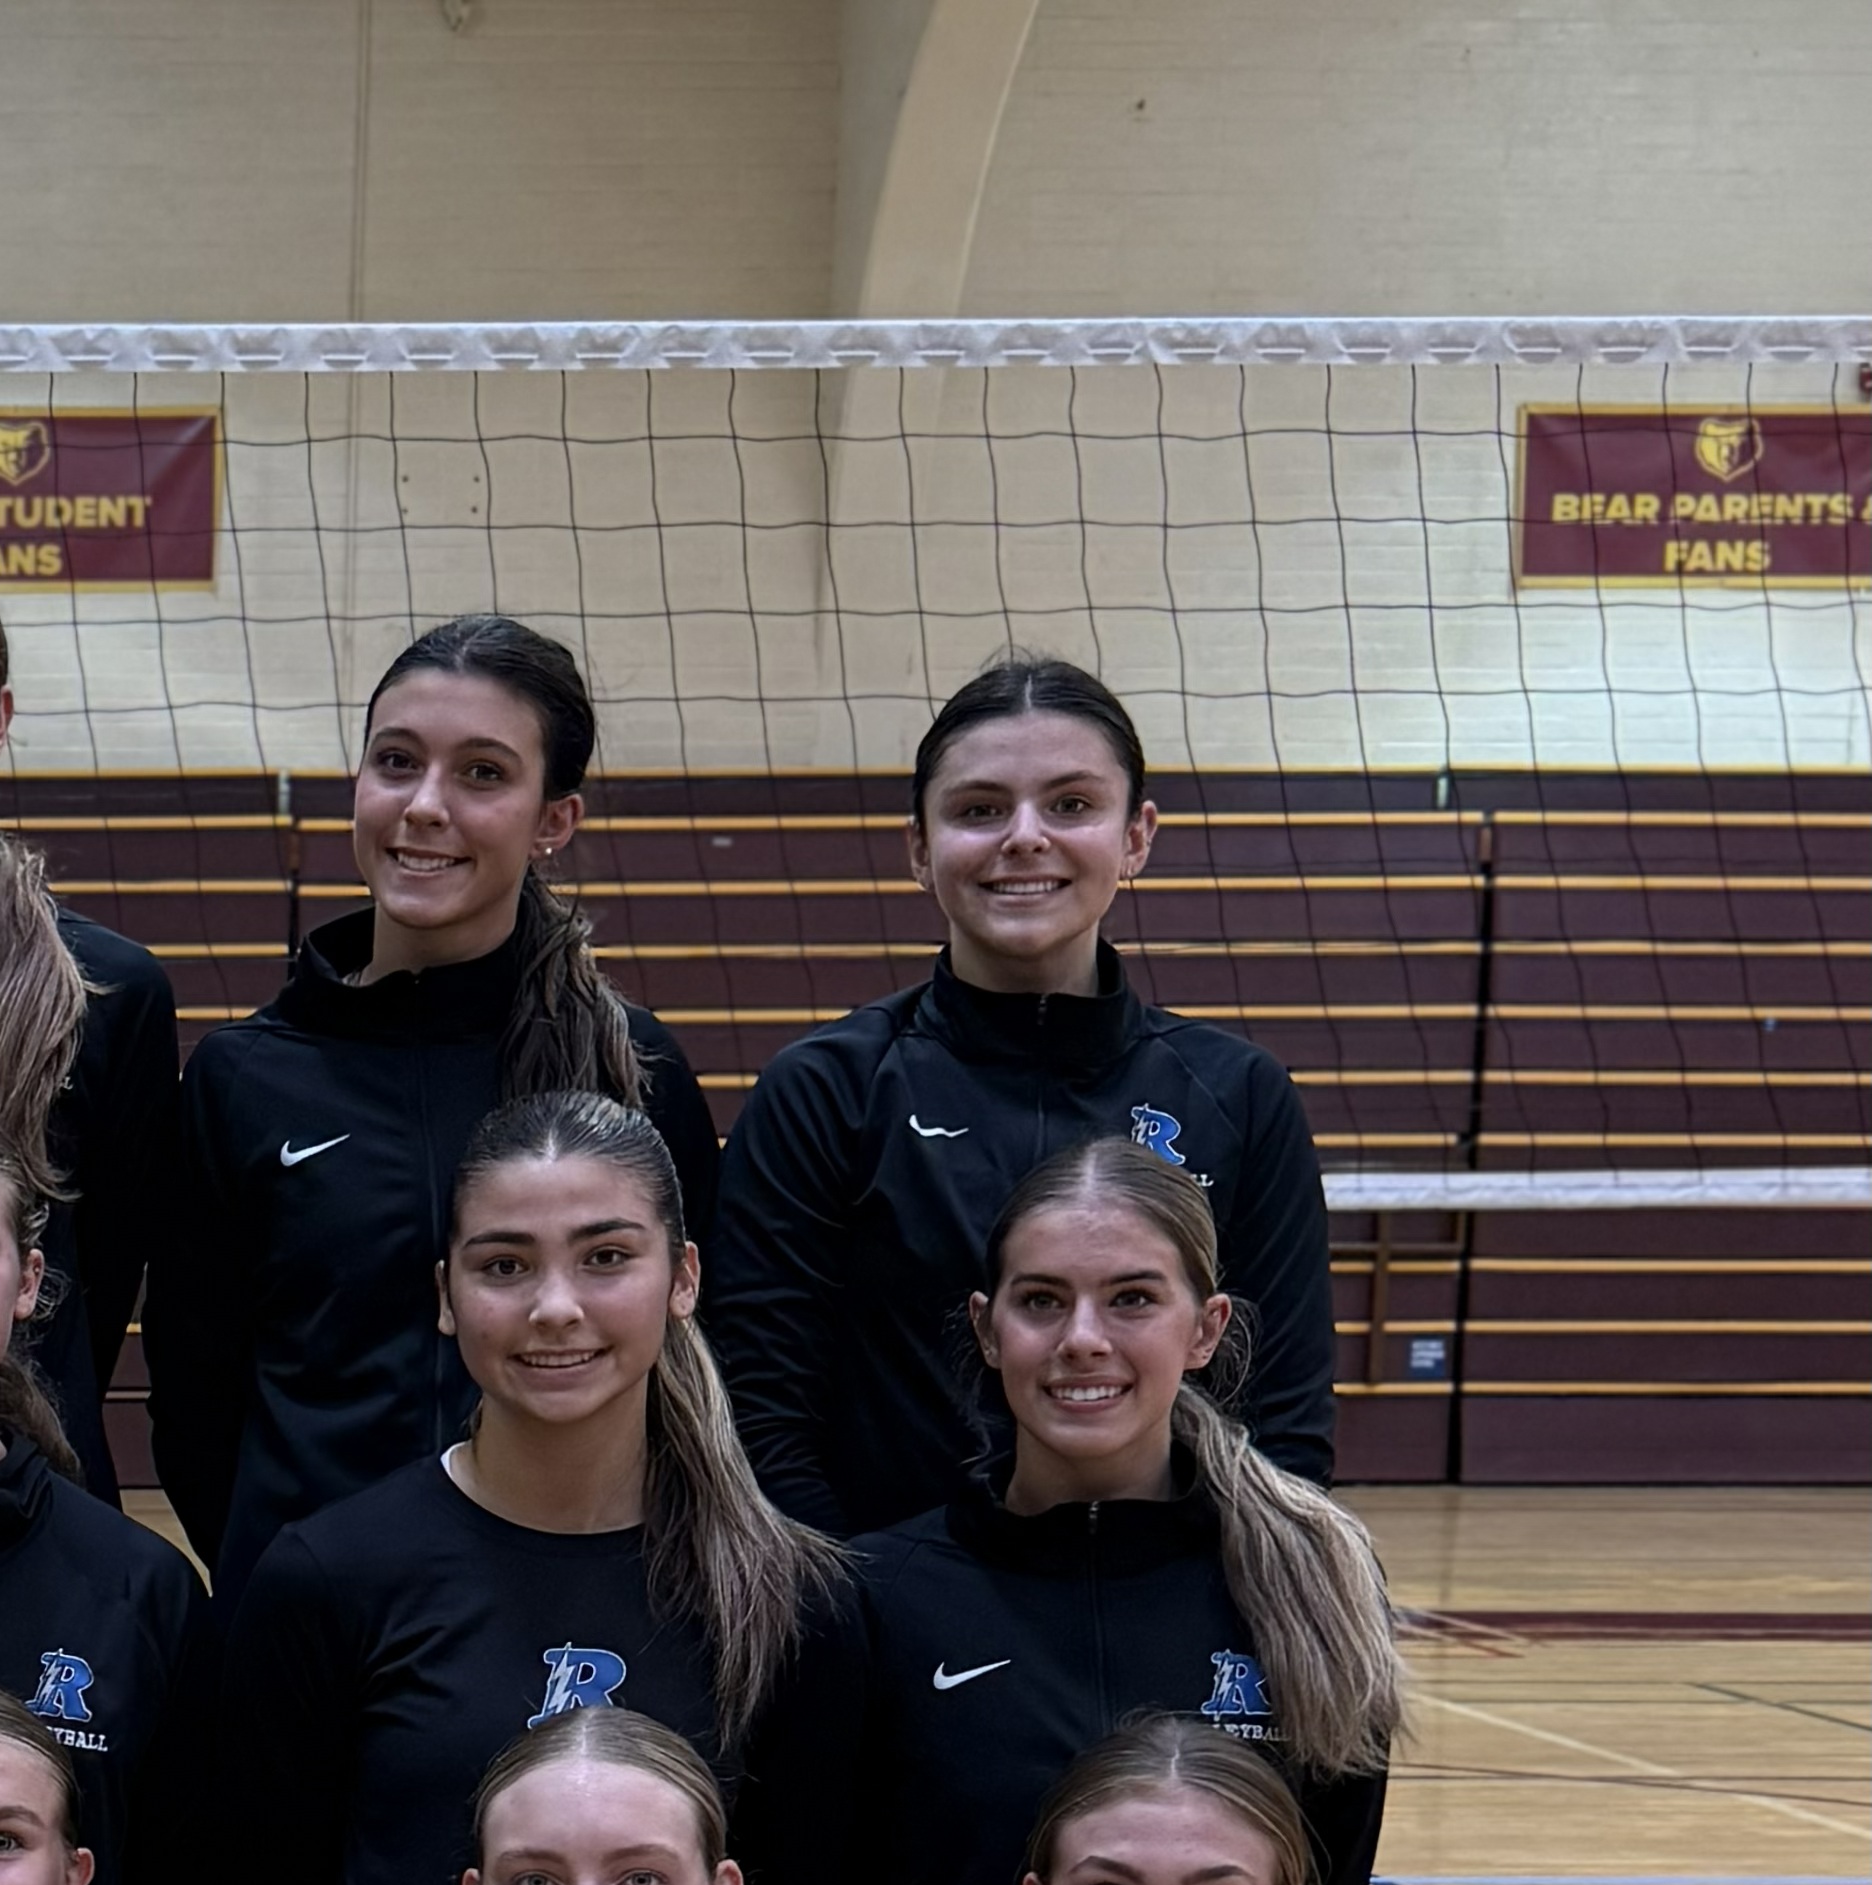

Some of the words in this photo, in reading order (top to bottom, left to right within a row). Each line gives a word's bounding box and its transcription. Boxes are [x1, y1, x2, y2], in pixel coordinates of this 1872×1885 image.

[1551, 493, 1661, 525] BEAR
[1670, 493, 1854, 525] PARENTS
[1664, 540, 1772, 572] FANS
[24, 1648, 95, 1722] R
[527, 1641, 627, 1729] R
[1200, 1648, 1272, 1721] R
